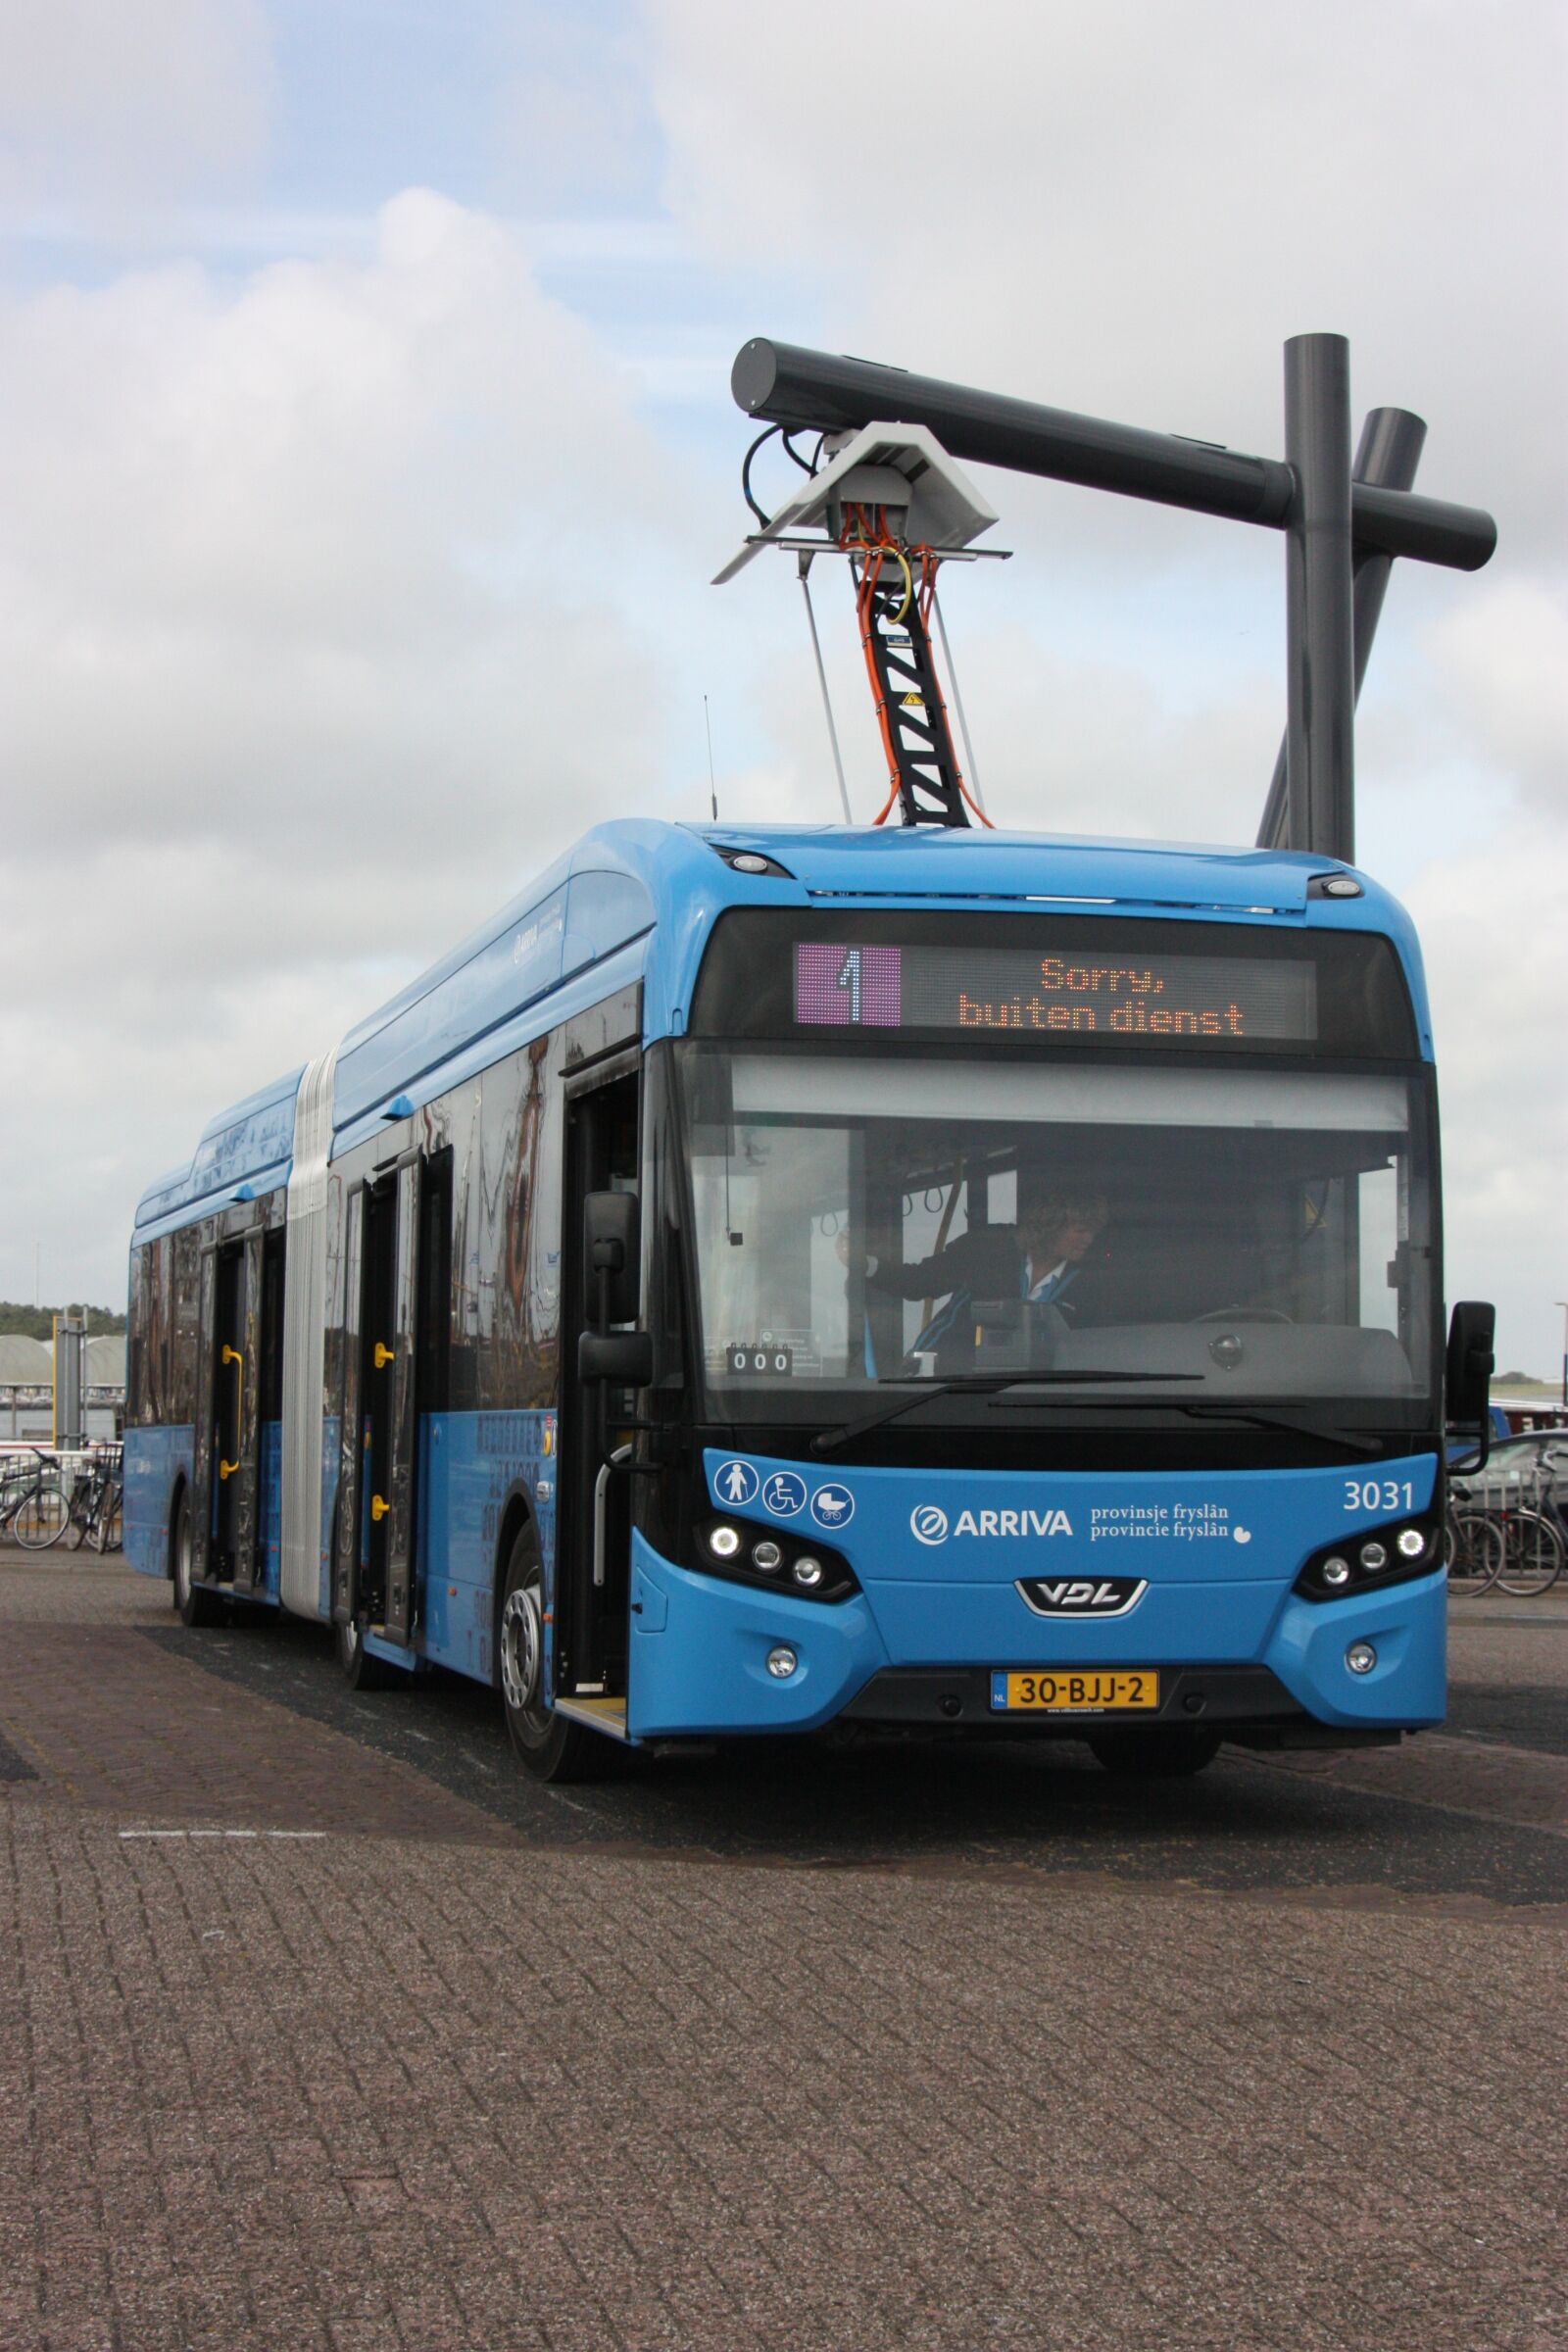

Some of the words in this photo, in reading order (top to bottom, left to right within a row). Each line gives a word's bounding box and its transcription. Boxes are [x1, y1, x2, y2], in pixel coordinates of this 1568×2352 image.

[840, 950, 859, 1022] 1
[1041, 957, 1163, 994] Sorry,
[958, 994, 1095, 1030] buiten
[1110, 1001, 1244, 1035] dienst
[1344, 1481, 1412, 1510] 3031
[954, 1510, 1073, 1536] ARRIVA
[1090, 1507, 1168, 1526] provinsje
[1173, 1504, 1229, 1524] fryslân
[1090, 1524, 1169, 1541] provincie
[1173, 1521, 1229, 1542] fryslân
[1036, 1583, 1121, 1605] VDL
[1020, 1677, 1145, 1704] 30-BJJ-2
